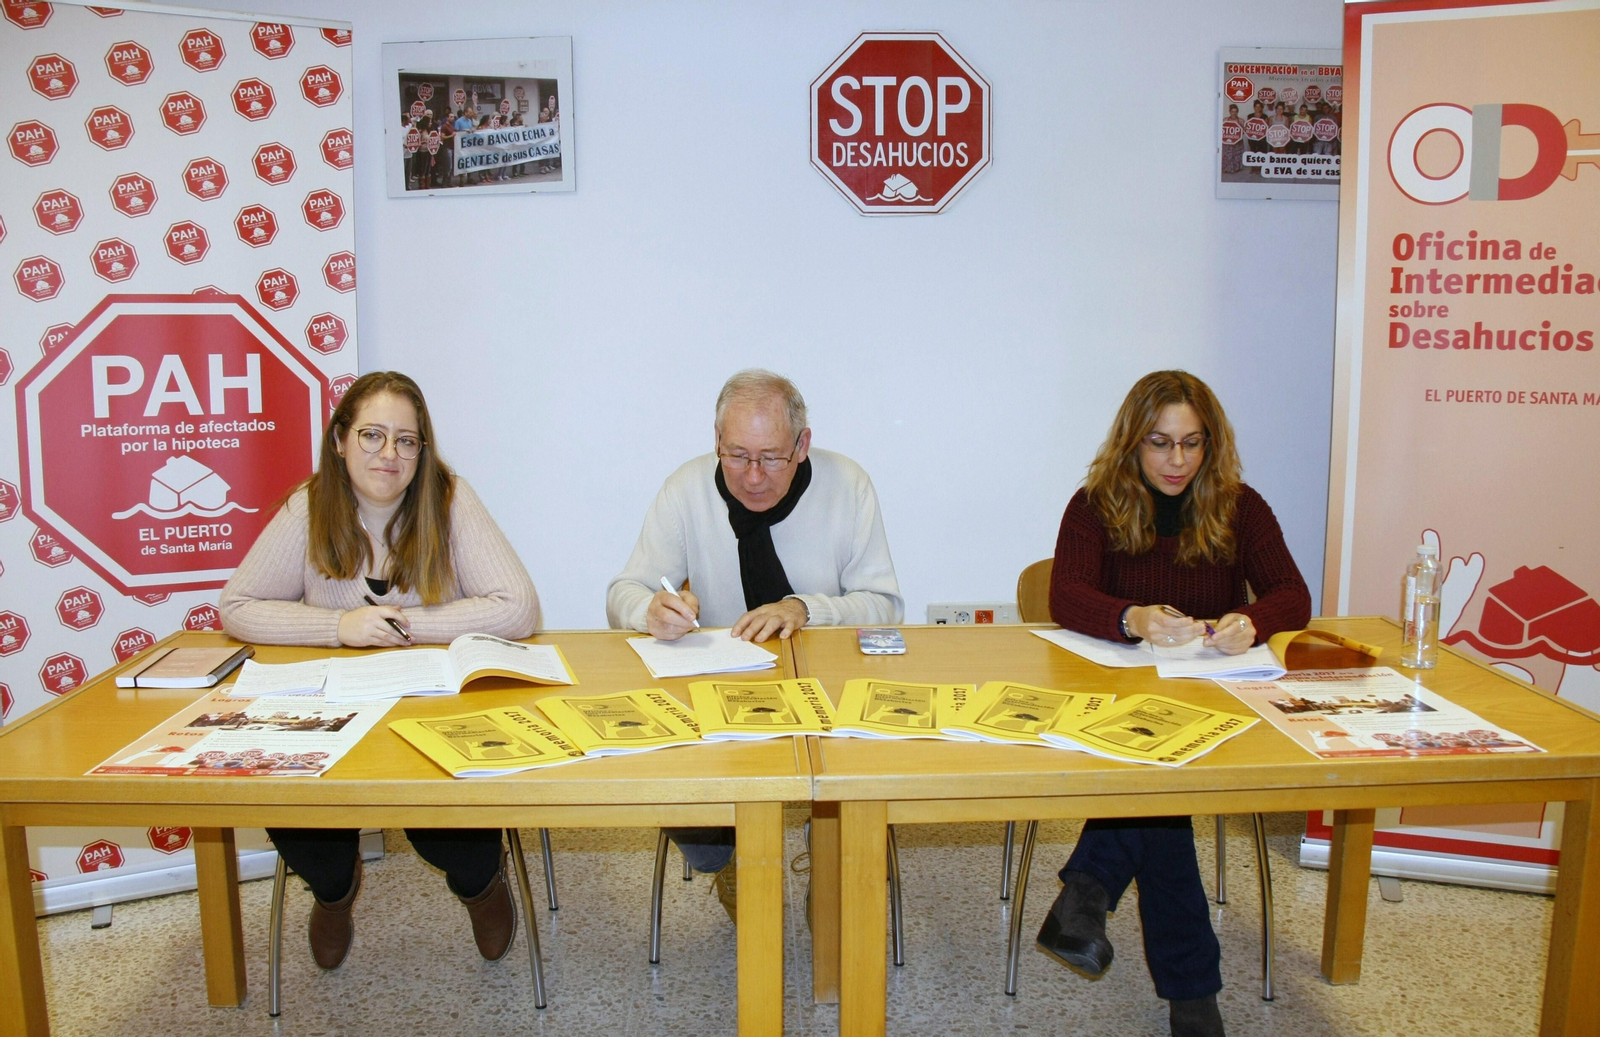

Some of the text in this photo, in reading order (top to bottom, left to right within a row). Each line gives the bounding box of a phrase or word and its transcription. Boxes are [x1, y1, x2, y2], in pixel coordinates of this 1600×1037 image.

[257, 24, 283, 36] PAH
[186, 35, 214, 48] PAH
[113, 48, 141, 62] PAH
[36, 61, 65, 75] PAH
[1318, 67, 1342, 76] BBVA
[307, 72, 332, 85] PAH
[238, 85, 264, 99] PAH
[1282, 91, 1297, 99] STOP
[167, 98, 194, 112] PAH
[828, 75, 971, 137] STOP
[93, 113, 121, 127] PAH
[1246, 122, 1266, 132] STOP
[1268, 129, 1287, 138] STOP
[1292, 124, 1311, 133] STOP
[1316, 123, 1335, 132] STOP
[15, 128, 45, 143] PAH
[327, 134, 352, 148] PAH
[461, 128, 555, 148] Este BANCO ECHA a
[260, 150, 285, 163] PAH
[457, 152, 500, 169] GENTES
[528, 143, 560, 158] CASAS
[832, 141, 969, 168] DESAHUCIOS
[1246, 155, 1266, 163] Este
[1269, 155, 1298, 164] banco
[1301, 156, 1331, 167] quiere
[190, 164, 217, 178] PAH
[1274, 167, 1293, 175] EVA
[1296, 167, 1307, 175] de
[117, 180, 145, 194] PAH
[41, 197, 70, 211] PAH
[309, 196, 334, 209] PAH
[241, 211, 266, 225] PAH
[171, 228, 198, 242] PAH
[98, 245, 126, 259] PAH
[1392, 230, 1557, 262] Oficina de
[22, 263, 51, 277] PAH
[330, 257, 354, 271] PAH
[263, 275, 288, 288] PAH
[1389, 263, 1600, 295] Intermedia
[1388, 300, 1449, 318] sobre
[312, 319, 337, 333] PAH
[1388, 320, 1594, 352] Desahucios
[91, 353, 263, 419] PAH
[1425, 388, 1442, 402] EL
[1445, 390, 1503, 404] PUERTO
[1506, 390, 1526, 404] DE
[1529, 391, 1579, 405] SANTA
[80, 419, 276, 438] Plataforma de afectados
[121, 436, 240, 455] por la hipoteca
[139, 523, 232, 542] EL PUERTO
[140, 539, 233, 556] de Santa María
[64, 592, 91, 609] PAH
[189, 609, 216, 626] PAH
[119, 633, 146, 650] PAH
[46, 659, 74, 675] PAH
[953, 687, 967, 702] 2017
[797, 682, 833, 725] memoria 2017
[1084, 696, 1104, 712] 2017
[646, 693, 700, 733] memoria 2017
[503, 711, 574, 751] memoria 2017
[1171, 718, 1244, 757] memoria 2017
[84, 845, 111, 863] PAH
